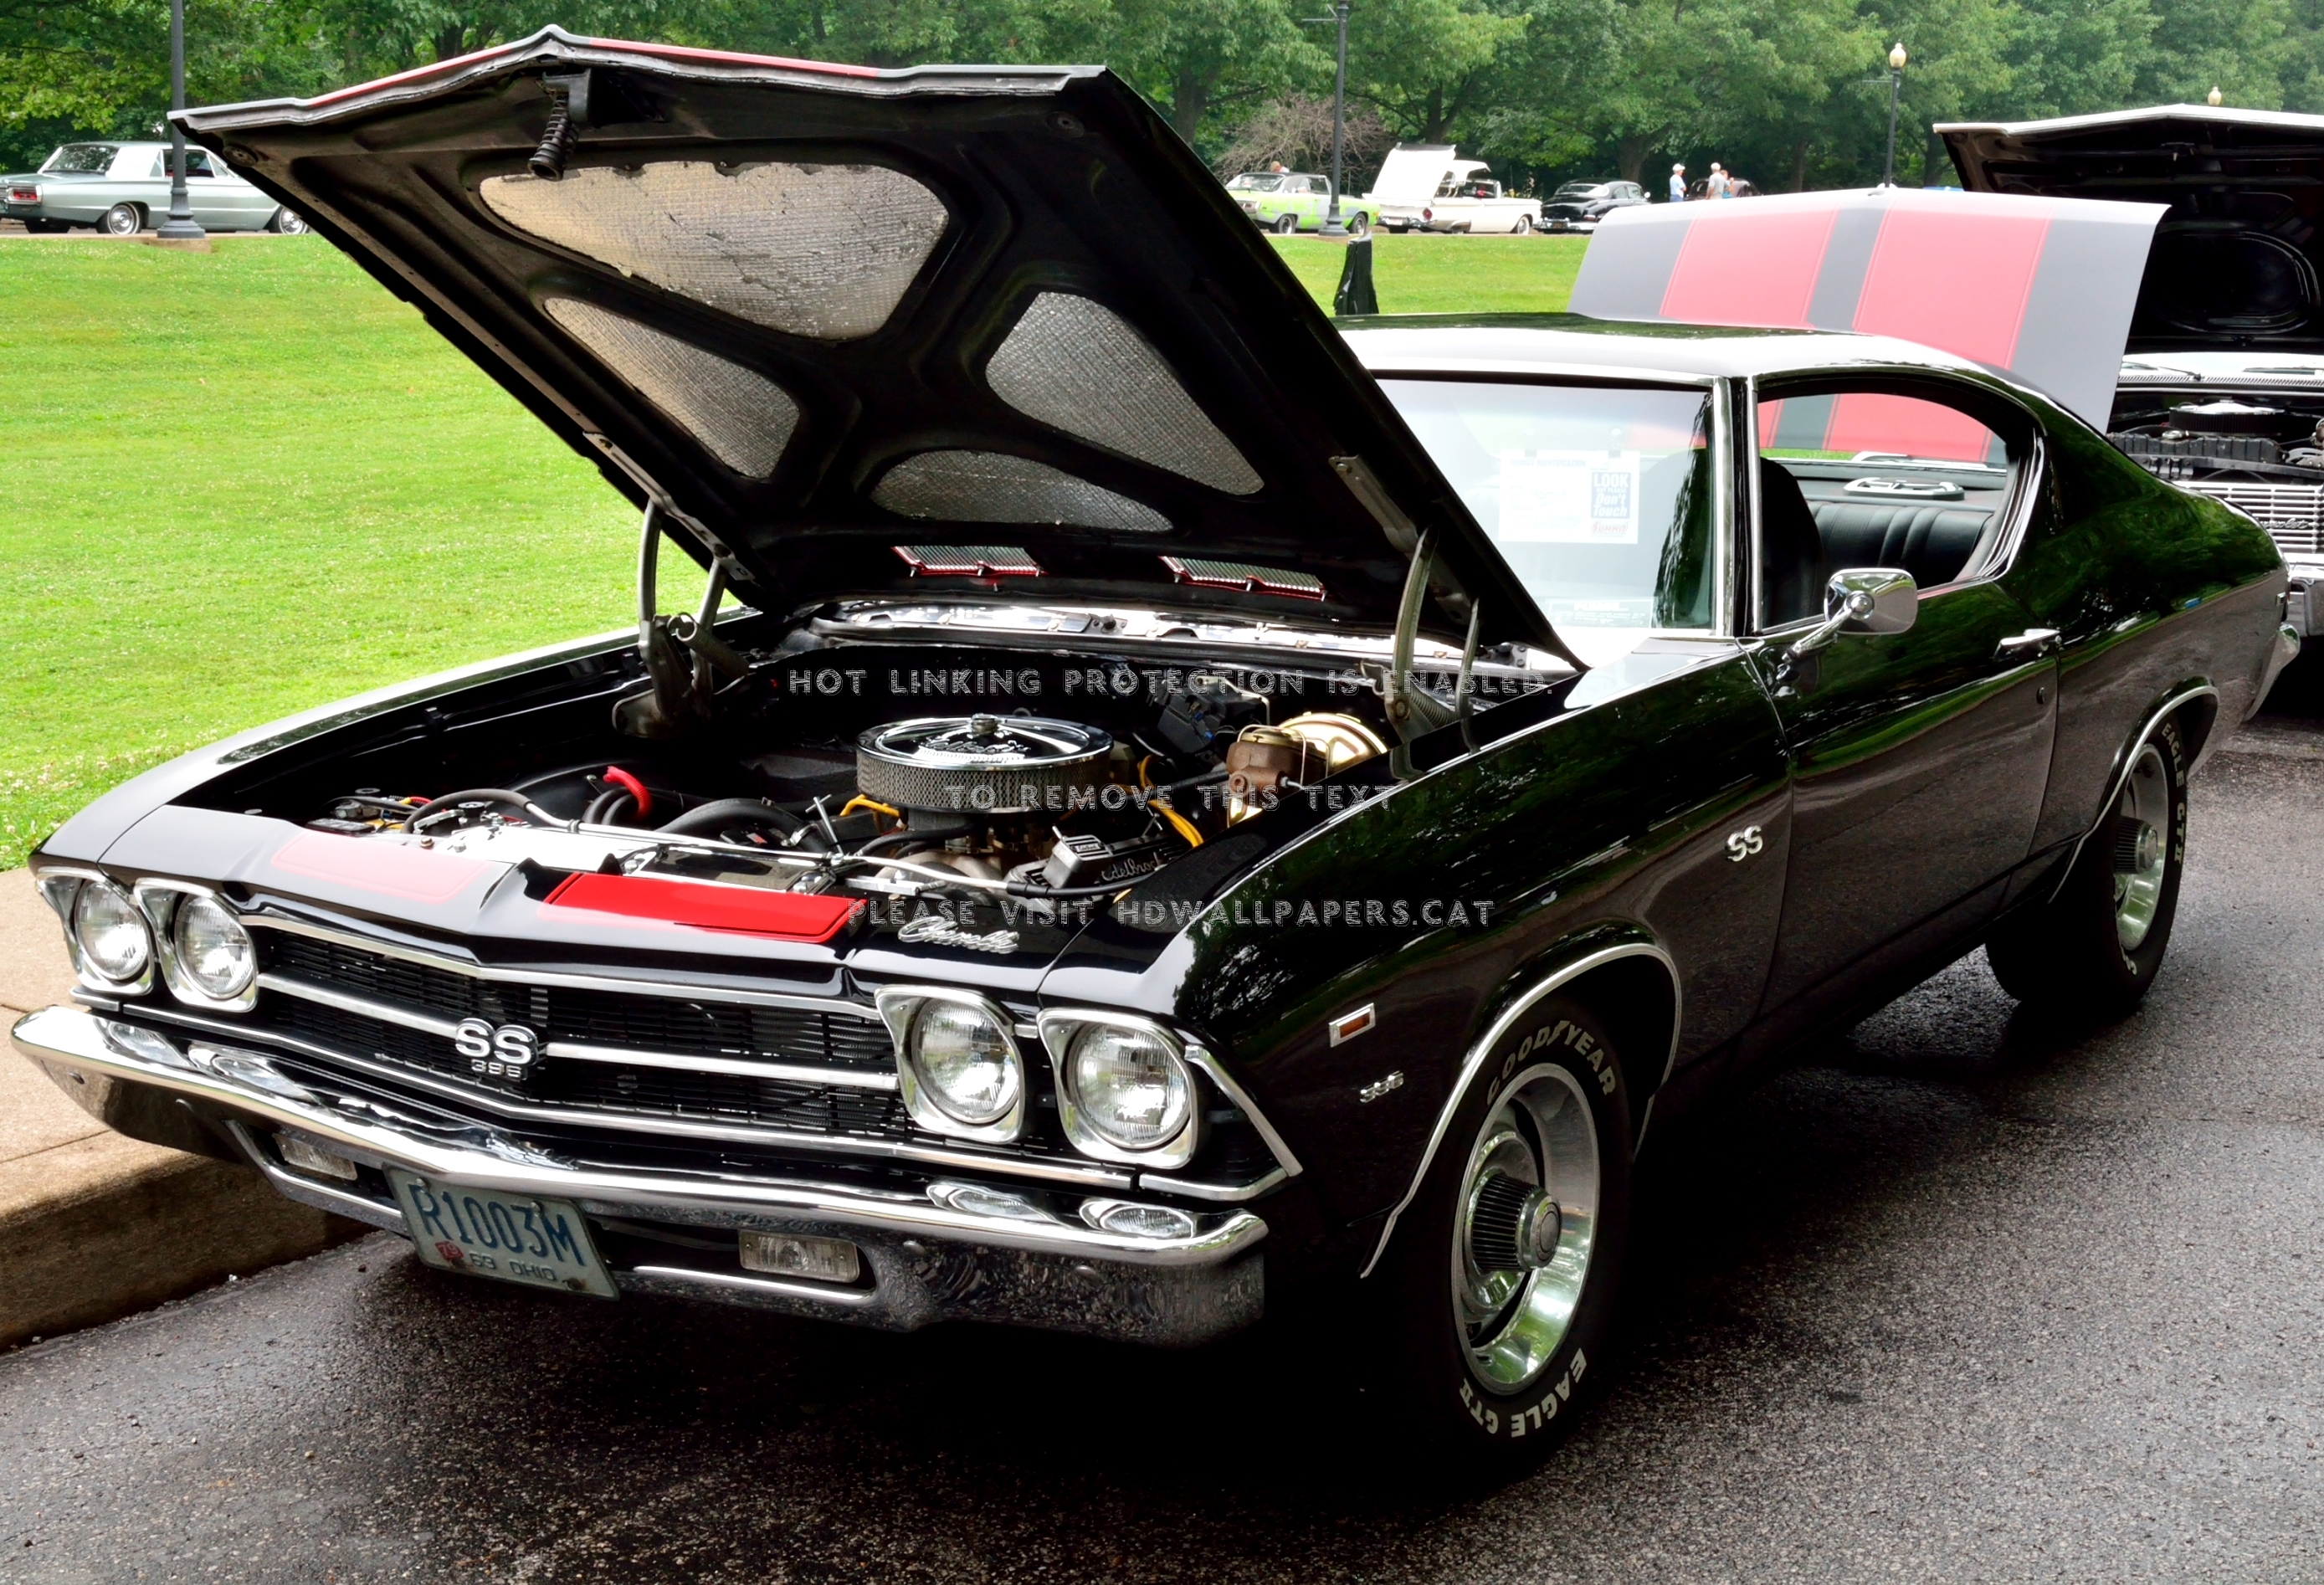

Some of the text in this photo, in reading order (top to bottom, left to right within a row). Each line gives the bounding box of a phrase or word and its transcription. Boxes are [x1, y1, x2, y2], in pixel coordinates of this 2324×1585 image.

[1593, 474, 1629, 488] LOOK
[1595, 493, 1627, 505] Don't
[1593, 505, 1628, 517] Touch
[2162, 723, 2185, 787] EAGLE
[1726, 824, 1763, 862] SS
[455, 1017, 540, 1066] SS
[471, 1058, 523, 1079] 396
[1487, 1019, 1616, 1105] GOODYEAR
[408, 1183, 587, 1266] R1003M
[509, 1259, 557, 1281] OHIO
[1511, 1347, 1588, 1438] EAGLE
